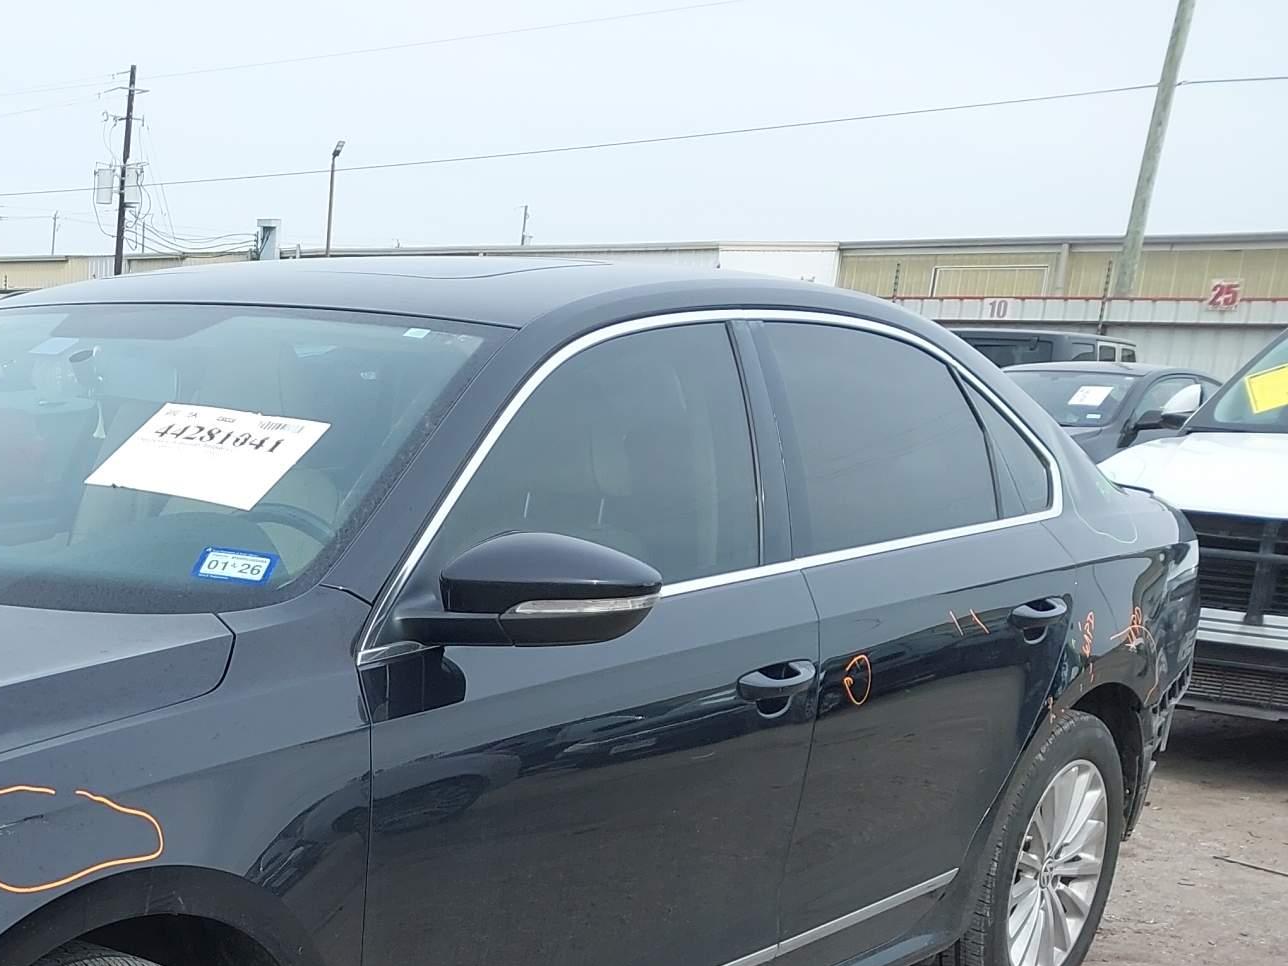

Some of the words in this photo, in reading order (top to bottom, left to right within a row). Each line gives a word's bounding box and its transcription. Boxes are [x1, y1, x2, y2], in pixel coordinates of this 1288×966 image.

[1209, 283, 1240, 306] 25
[989, 299, 1009, 319] 10
[154, 423, 285, 453] 44281041
[207, 559, 229, 571] 01
[237, 563, 263, 576] 26
